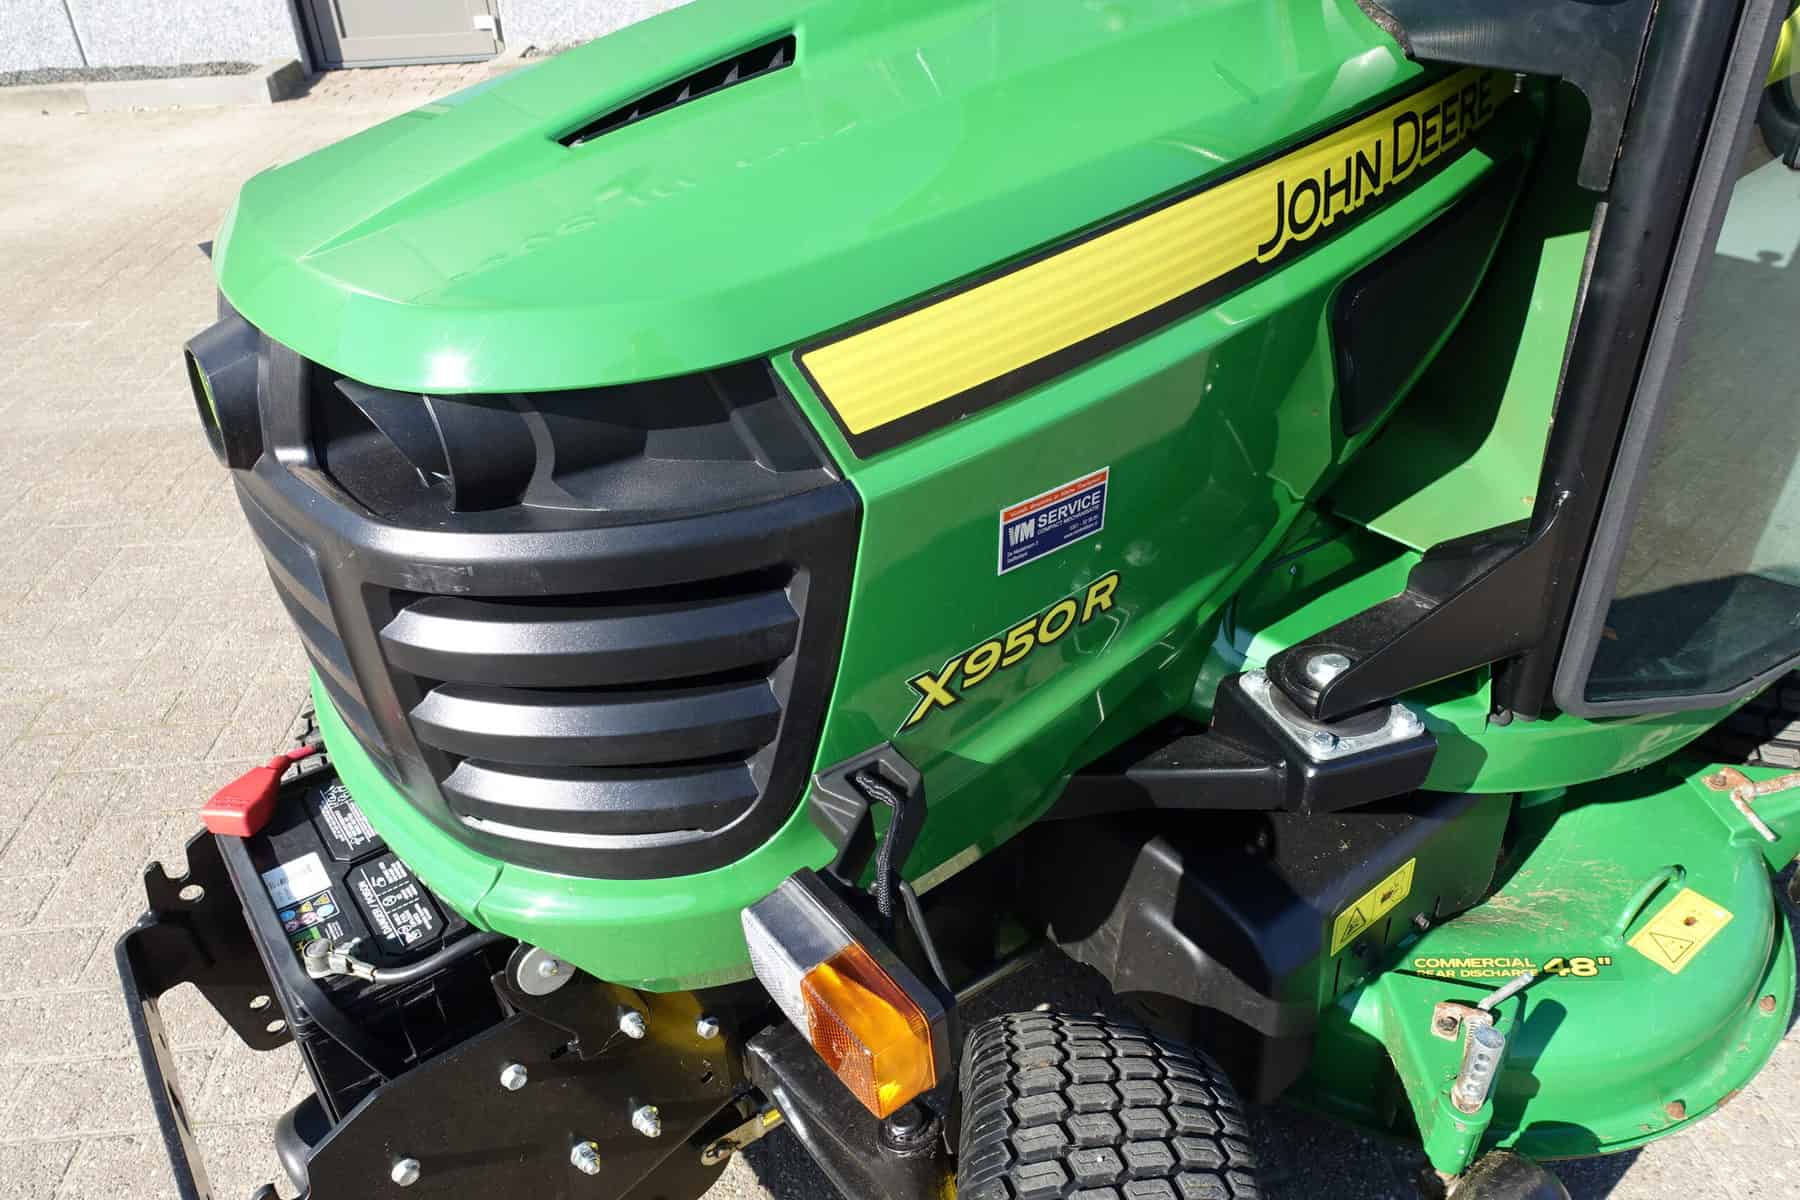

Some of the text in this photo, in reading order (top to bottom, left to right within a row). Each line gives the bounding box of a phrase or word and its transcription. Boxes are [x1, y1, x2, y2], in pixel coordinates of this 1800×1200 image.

[1257, 77, 1496, 260] JOHN DEERE
[1038, 490, 1101, 528] SERVICE
[1414, 957, 1537, 968] COMMERCIAL
